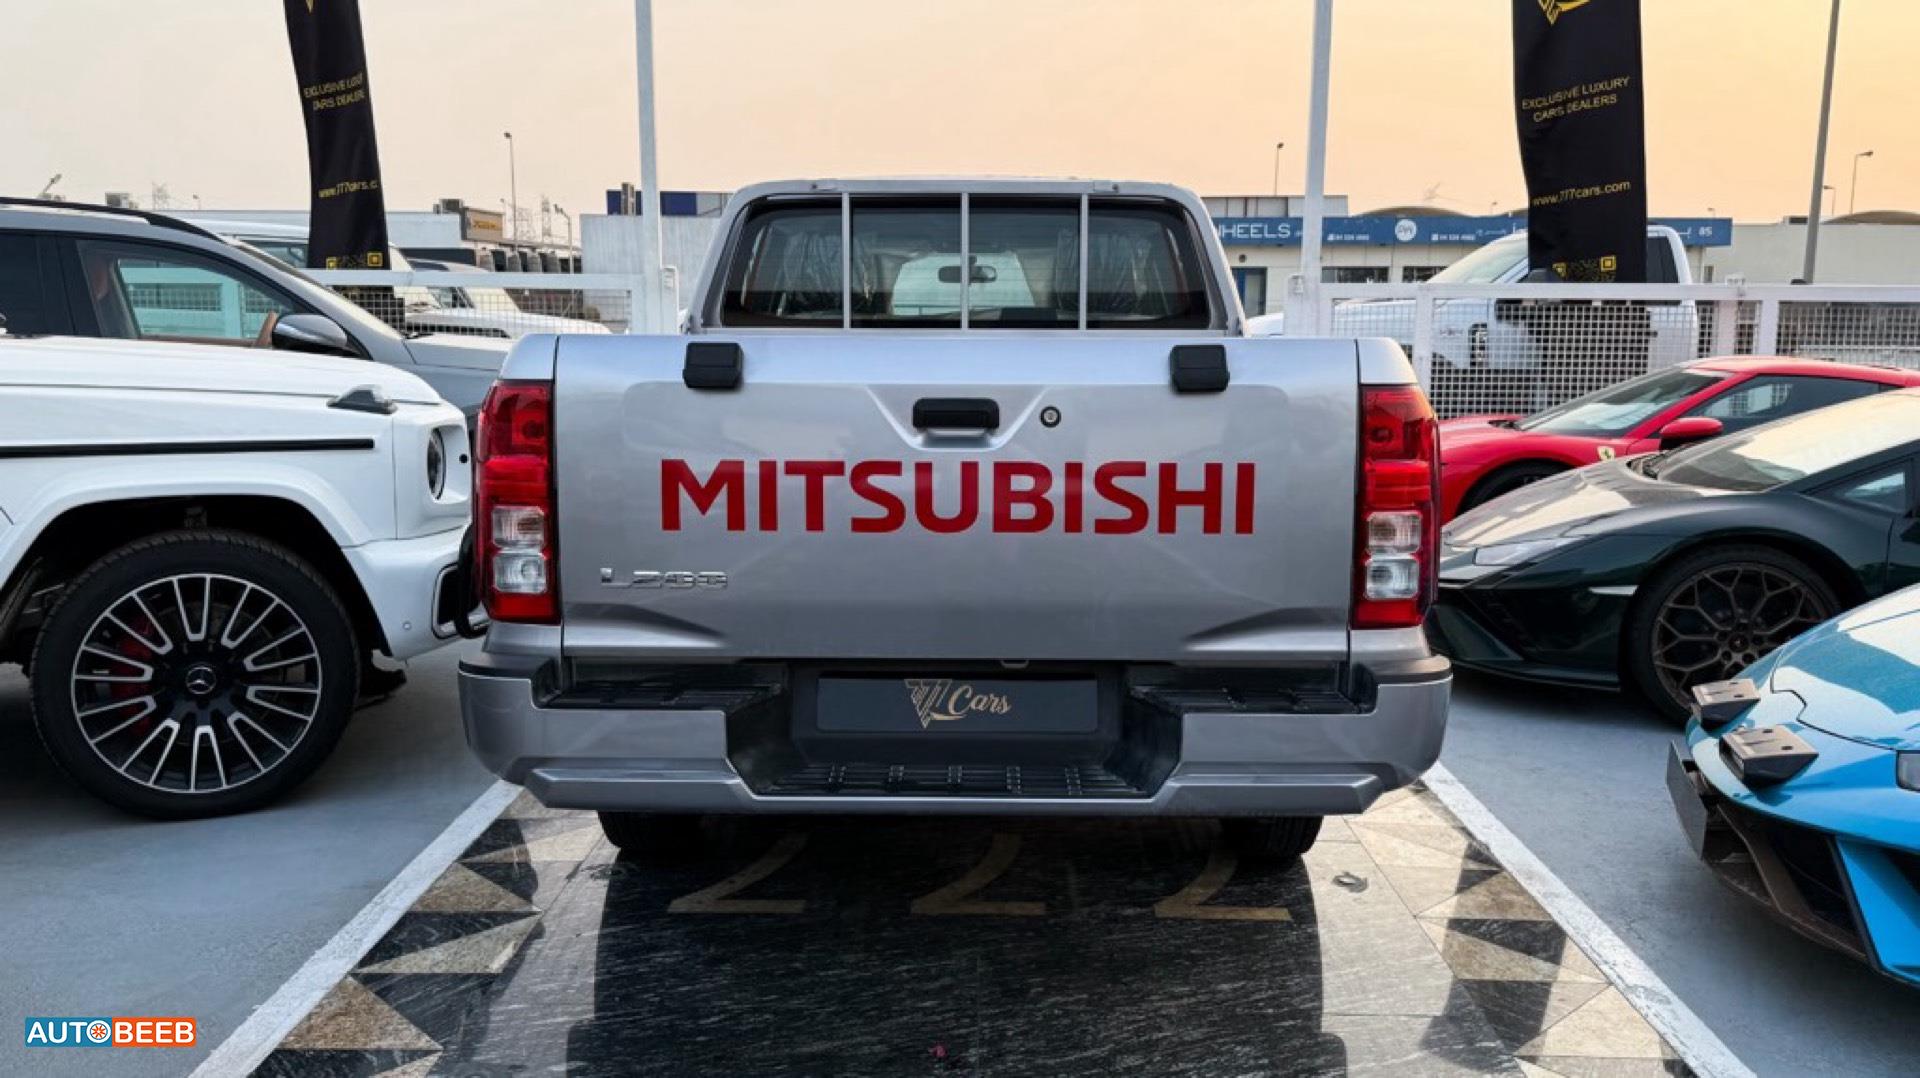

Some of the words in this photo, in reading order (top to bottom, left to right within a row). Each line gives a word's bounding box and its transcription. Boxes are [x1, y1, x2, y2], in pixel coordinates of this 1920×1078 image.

[1522, 86, 1580, 110] EXCLUSIVE
[1582, 76, 1630, 95] LUXURY
[1533, 106, 1565, 122] CARS
[1567, 93, 1618, 114] DEALERS
[1532, 181, 1631, 206] www.777cars.com
[1218, 223, 1291, 239] HEELS
[661, 459, 1255, 535] MITSUBISHI
[948, 685, 1012, 715] Cars
